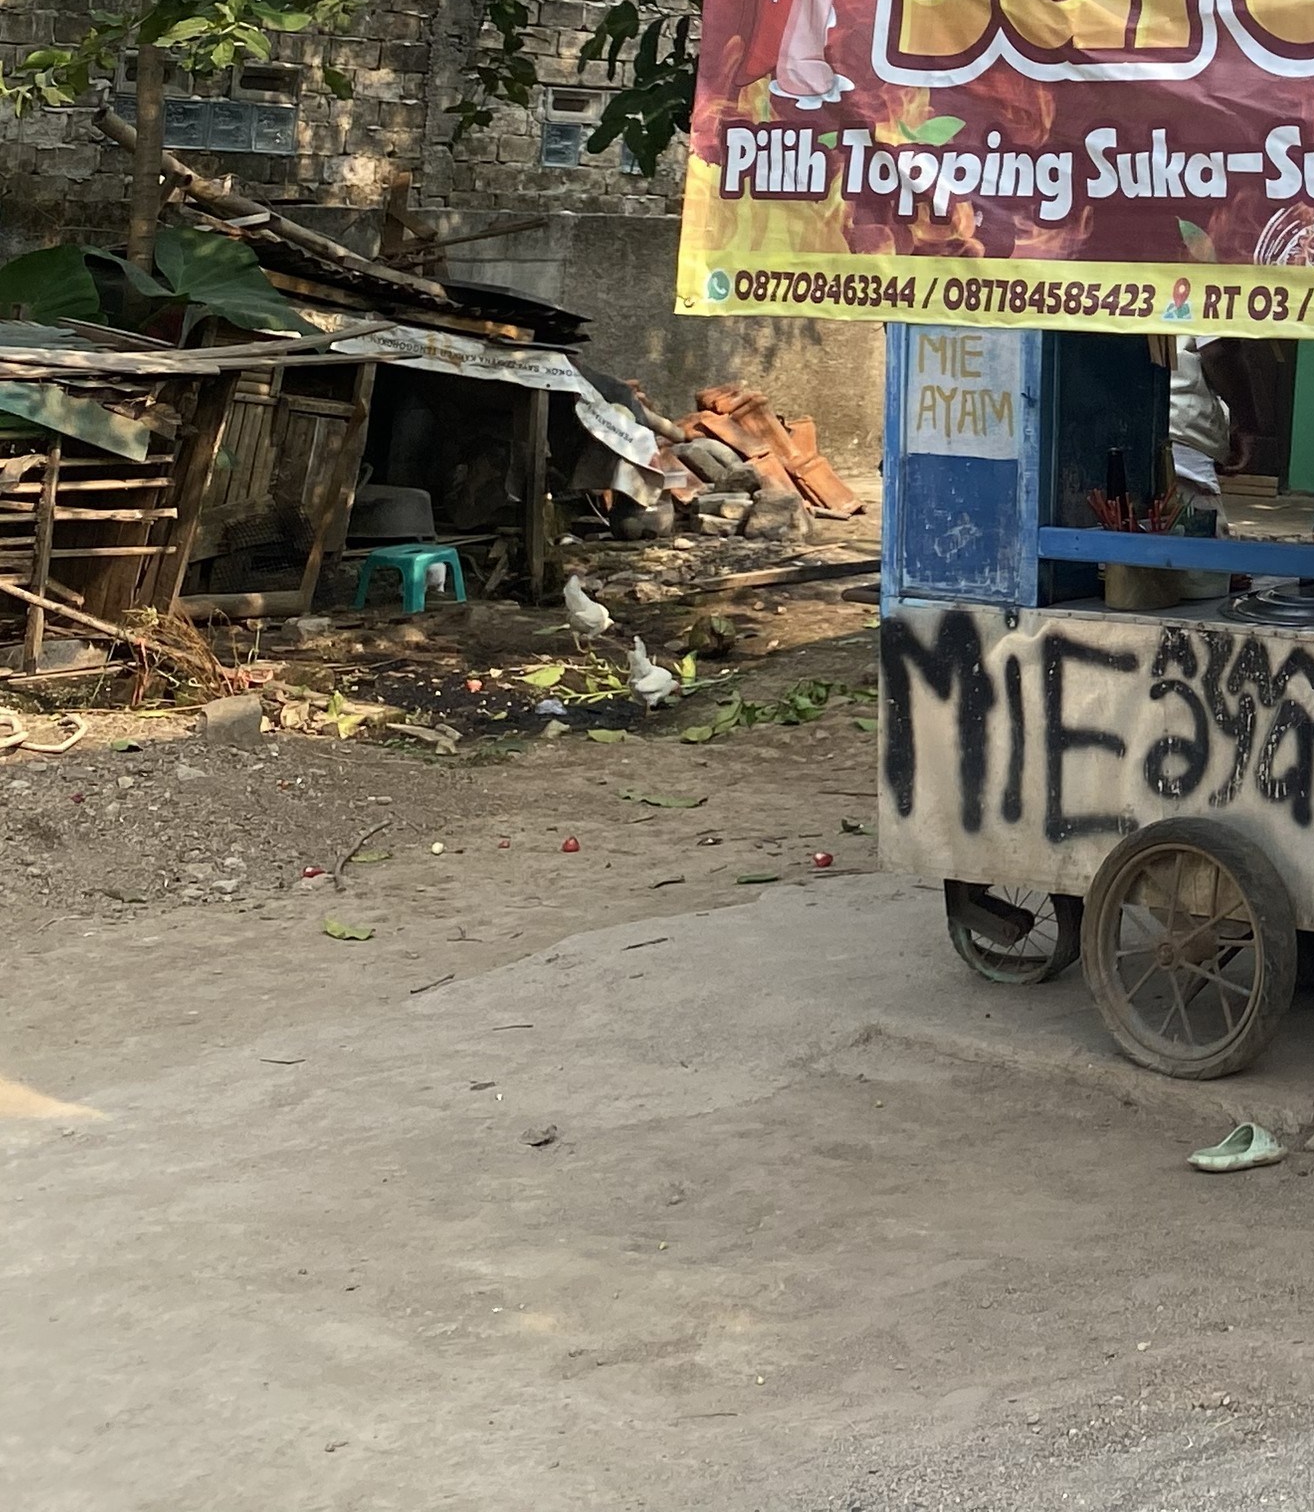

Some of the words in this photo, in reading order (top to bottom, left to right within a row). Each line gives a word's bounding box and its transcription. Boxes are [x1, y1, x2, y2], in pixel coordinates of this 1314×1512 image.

[725, 127, 827, 199] Pilih
[842, 131, 1074, 221] Topping
[734, 270, 916, 309] 087708463344
[942, 277, 1156, 318] 087784585423
[1202, 285, 1243, 321] RT
[916, 333, 984, 379] MIE
[915, 384, 1014, 439] AYAM
[881, 610, 1139, 842] MIE
